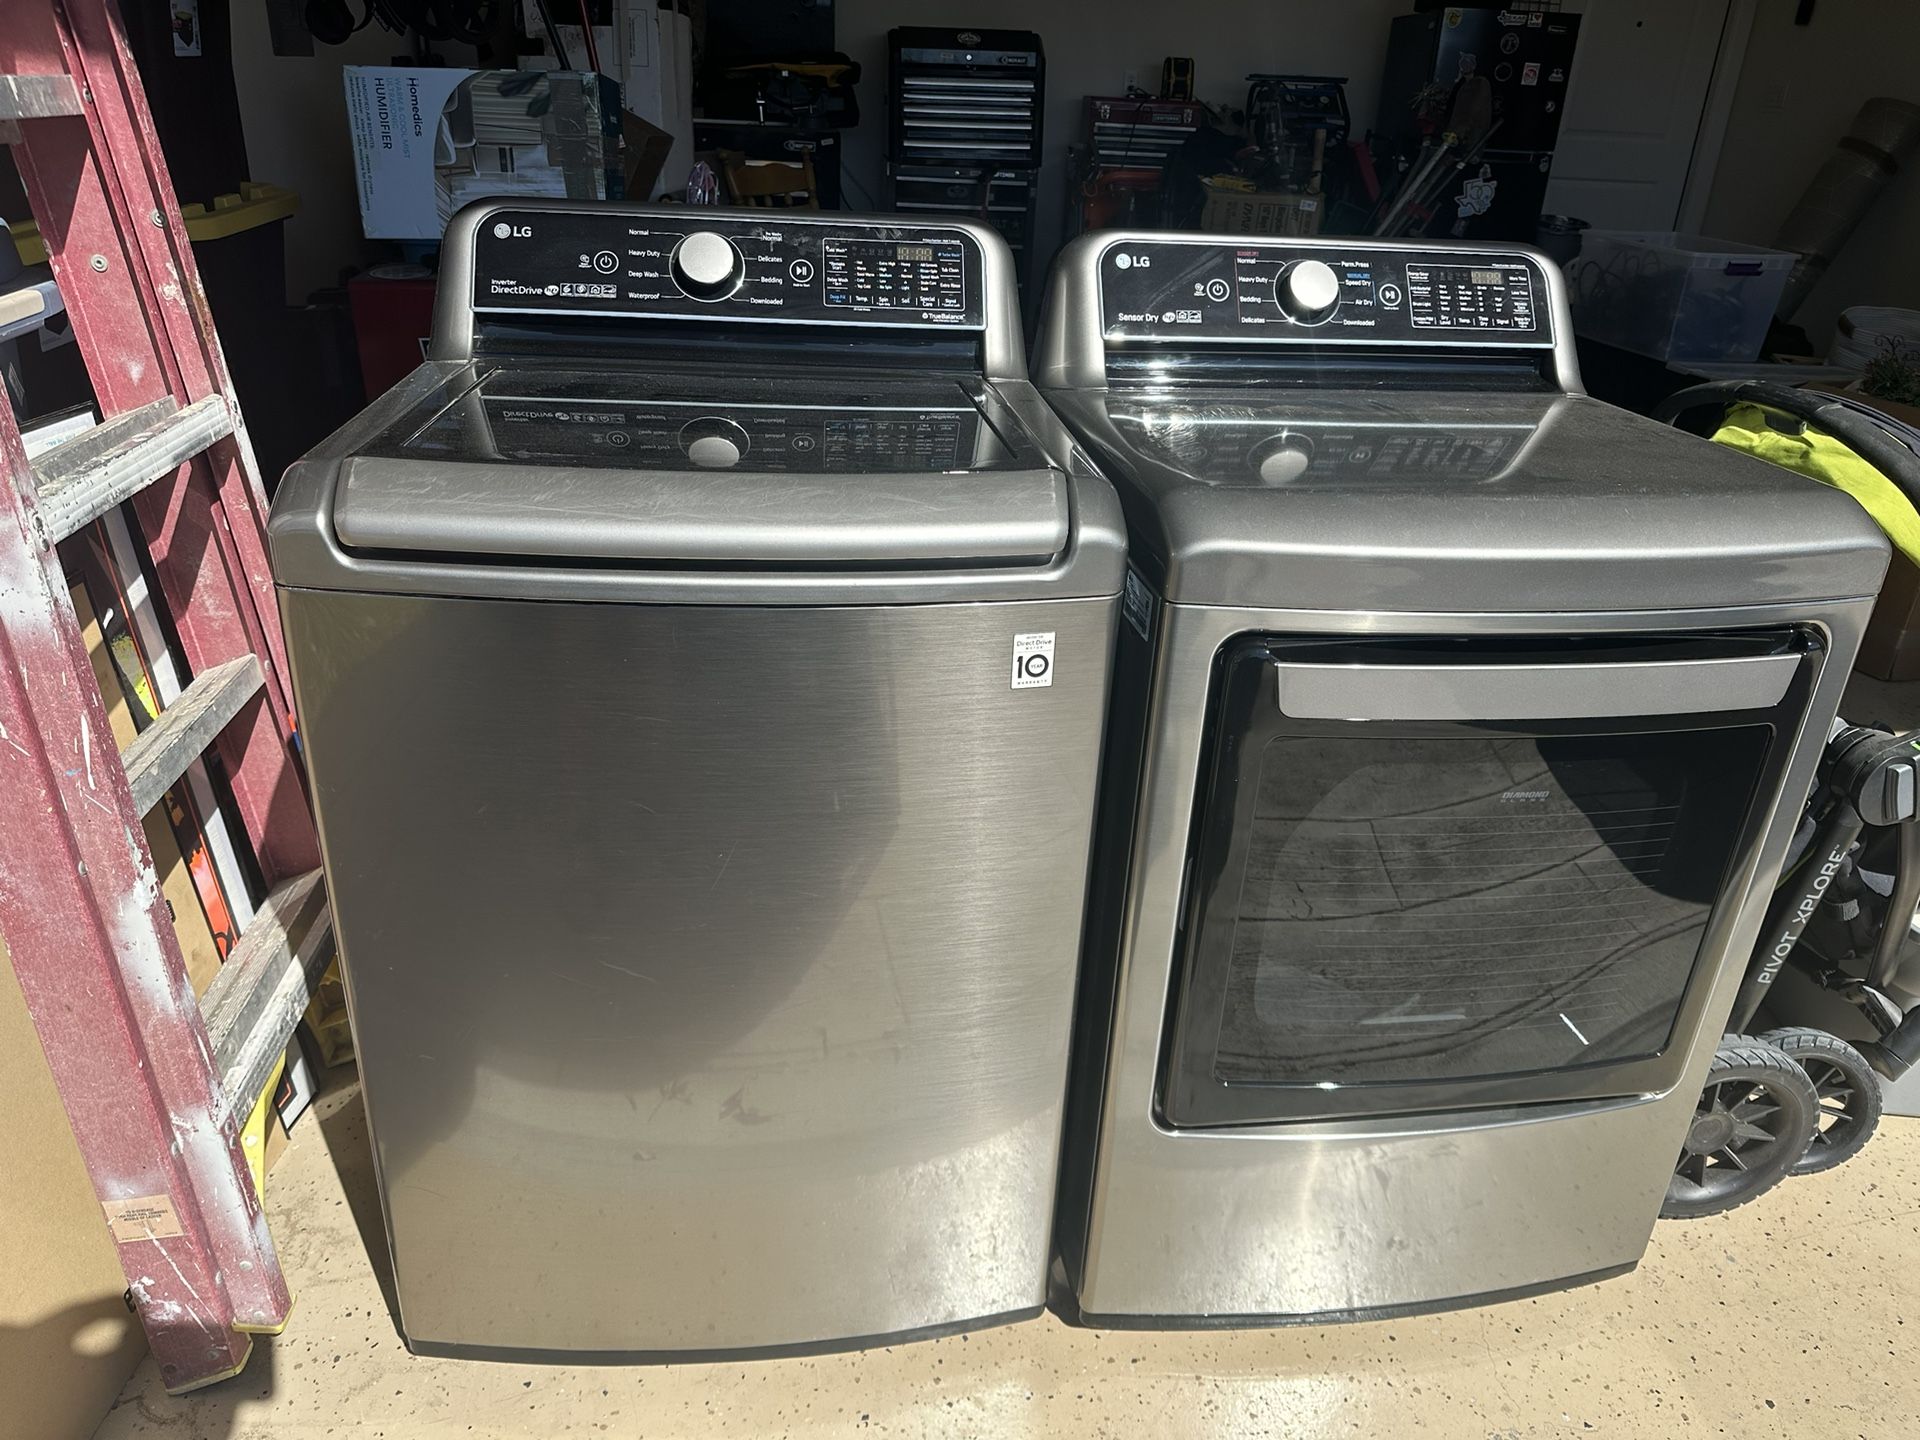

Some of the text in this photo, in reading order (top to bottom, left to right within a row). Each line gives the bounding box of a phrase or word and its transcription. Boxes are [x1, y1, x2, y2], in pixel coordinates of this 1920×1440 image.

[406, 77, 423, 137] Homedics
[374, 77, 393, 150] HUMIDIFIER
[513, 225, 532, 238] LG
[628, 228, 649, 236] Normal
[628, 249, 661, 259] Heavy Duty
[757, 255, 783, 263] Delicates
[1133, 256, 1150, 267] LG
[628, 270, 643, 279] Deep
[491, 278, 517, 287] Inverter
[760, 276, 783, 285] Bedding
[628, 291, 661, 301] Waterproof
[750, 297, 784, 305] Downloaded
[1118, 312, 1159, 324] Sensor Dry
[1016, 654, 1049, 679] 10
[1502, 791, 1550, 799] DIAMOND
[1757, 931, 1797, 984] PIVOT
